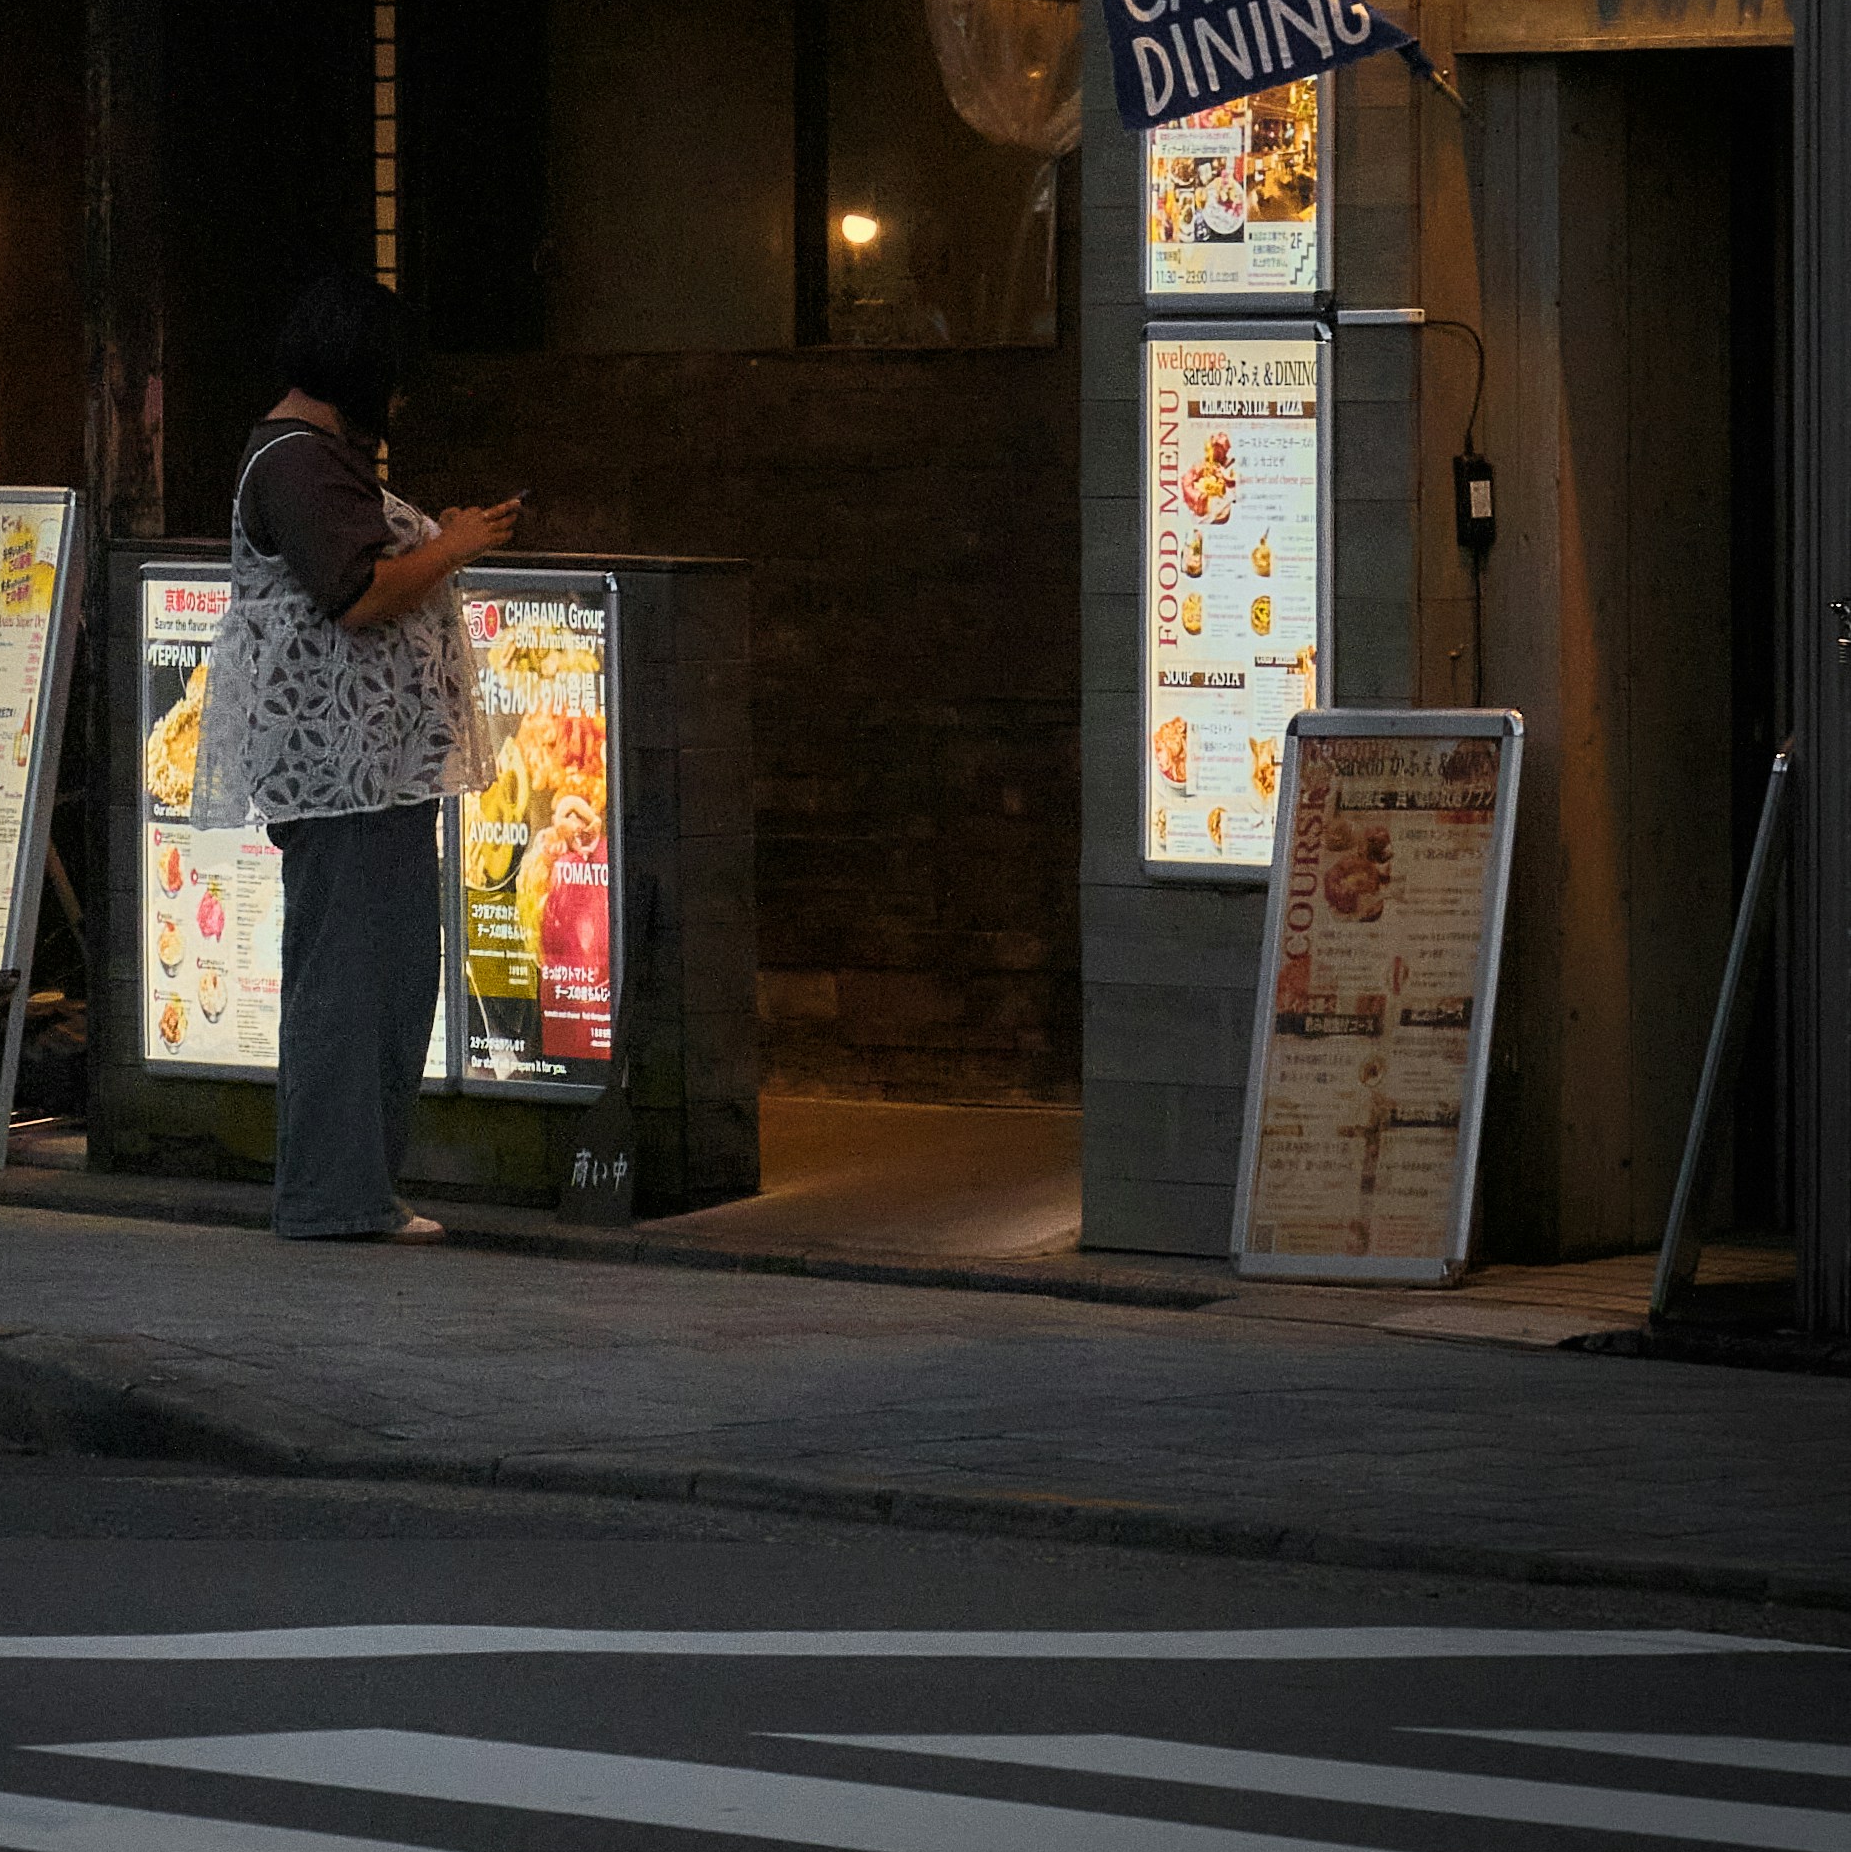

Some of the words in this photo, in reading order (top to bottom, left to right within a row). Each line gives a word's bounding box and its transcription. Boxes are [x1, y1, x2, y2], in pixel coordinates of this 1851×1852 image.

[1156, 345, 1227, 371] welcome
[1182, 363, 1222, 387] saredo
[1225, 360, 1260, 387] かふぇ
[1263, 362, 1273, 387] &
[1158, 387, 1180, 517] MENU
[165, 588, 233, 615] 京都のお出汁
[1158, 530, 1179, 649] FOOD
[505, 600, 567, 628] CHABANA
[568, 603, 606, 634] Group
[539, 628, 596, 654] Anniversary
[1164, 668, 1192, 686] SOUP
[1204, 669, 1241, 687] PASTA
[469, 821, 529, 846] AVOCADO
[555, 862, 609, 887] TOMATO
